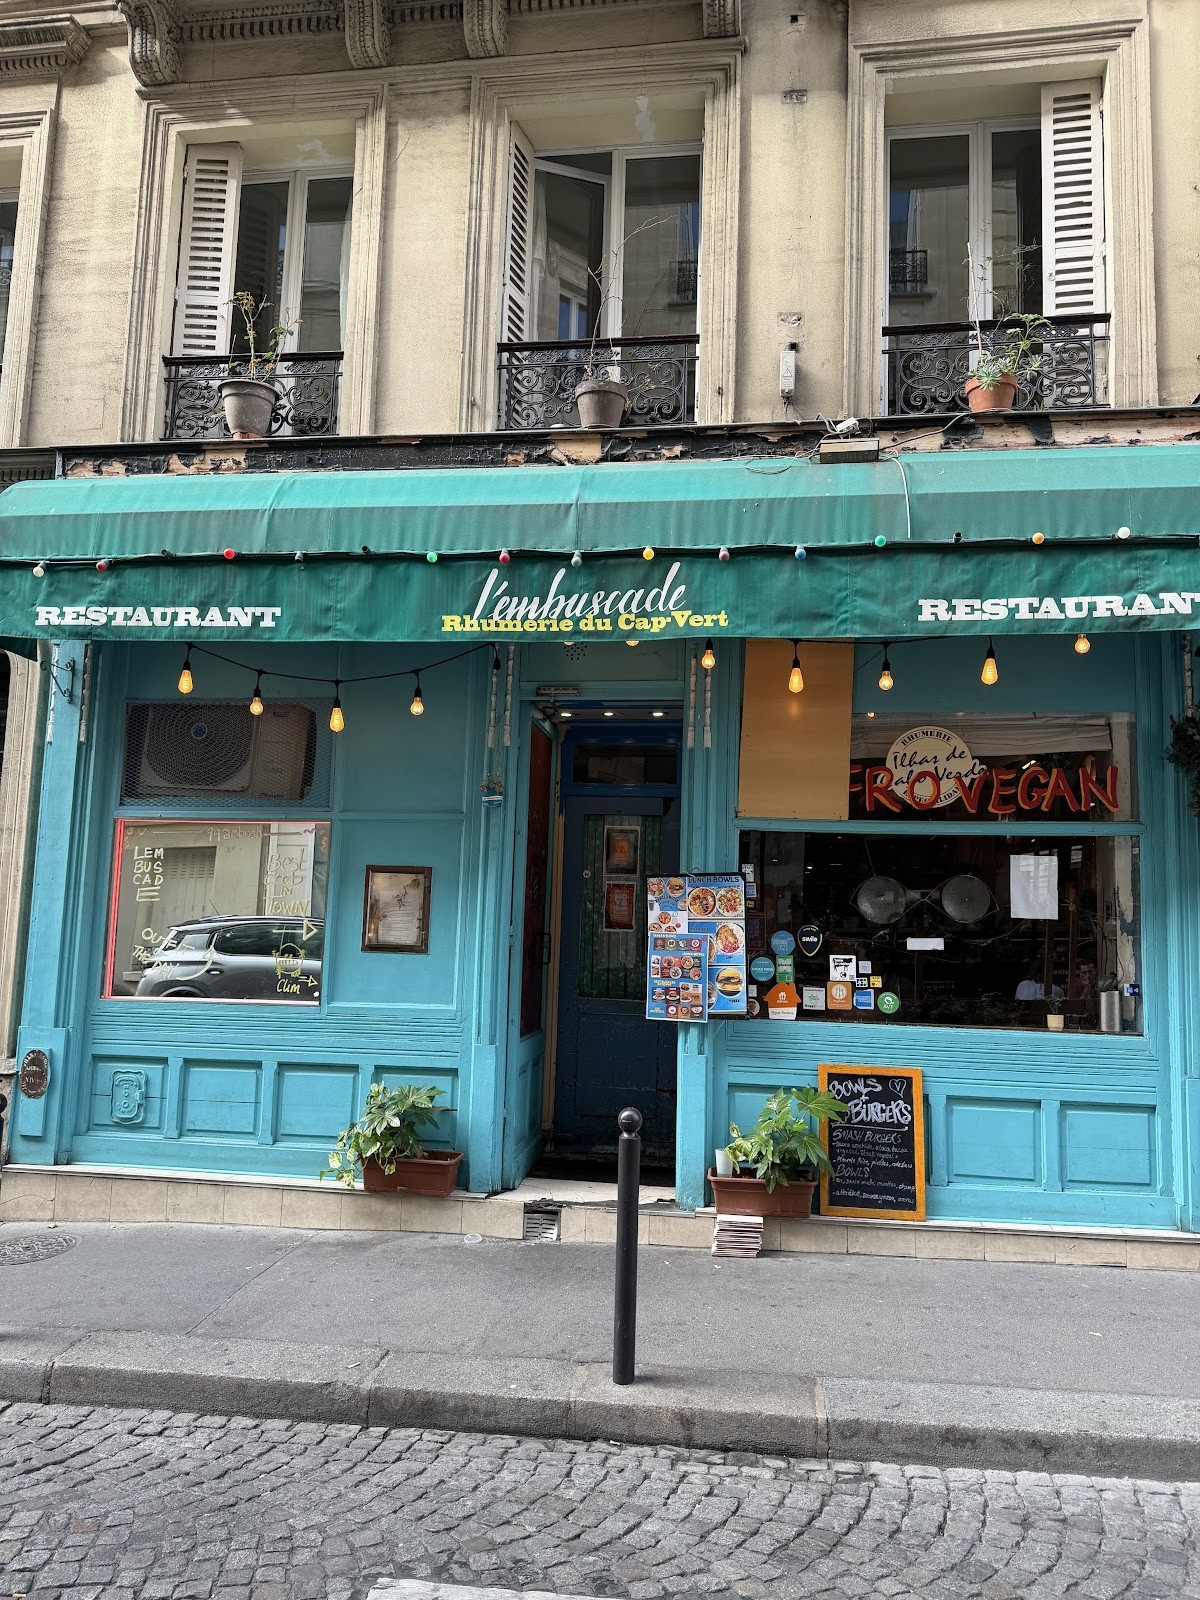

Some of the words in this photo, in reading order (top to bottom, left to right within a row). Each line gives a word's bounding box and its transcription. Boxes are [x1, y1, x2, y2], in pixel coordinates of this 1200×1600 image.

[35, 606, 281, 627] RESTAURANT
[441, 614, 574, 632] Rhumerie
[579, 613, 612, 631] du
[901, 730, 952, 746] RHUMERIE
[945, 745, 967, 762] de
[955, 766, 1119, 813] VEGAN
[134, 846, 164, 859] LEM
[133, 861, 163, 873] BUS
[133, 874, 163, 885] CAD
[136, 886, 160, 901] E
[263, 895, 310, 917] TOWN
[829, 1077, 883, 1100] BOWLS
[835, 1163, 870, 1178] BOWLS
